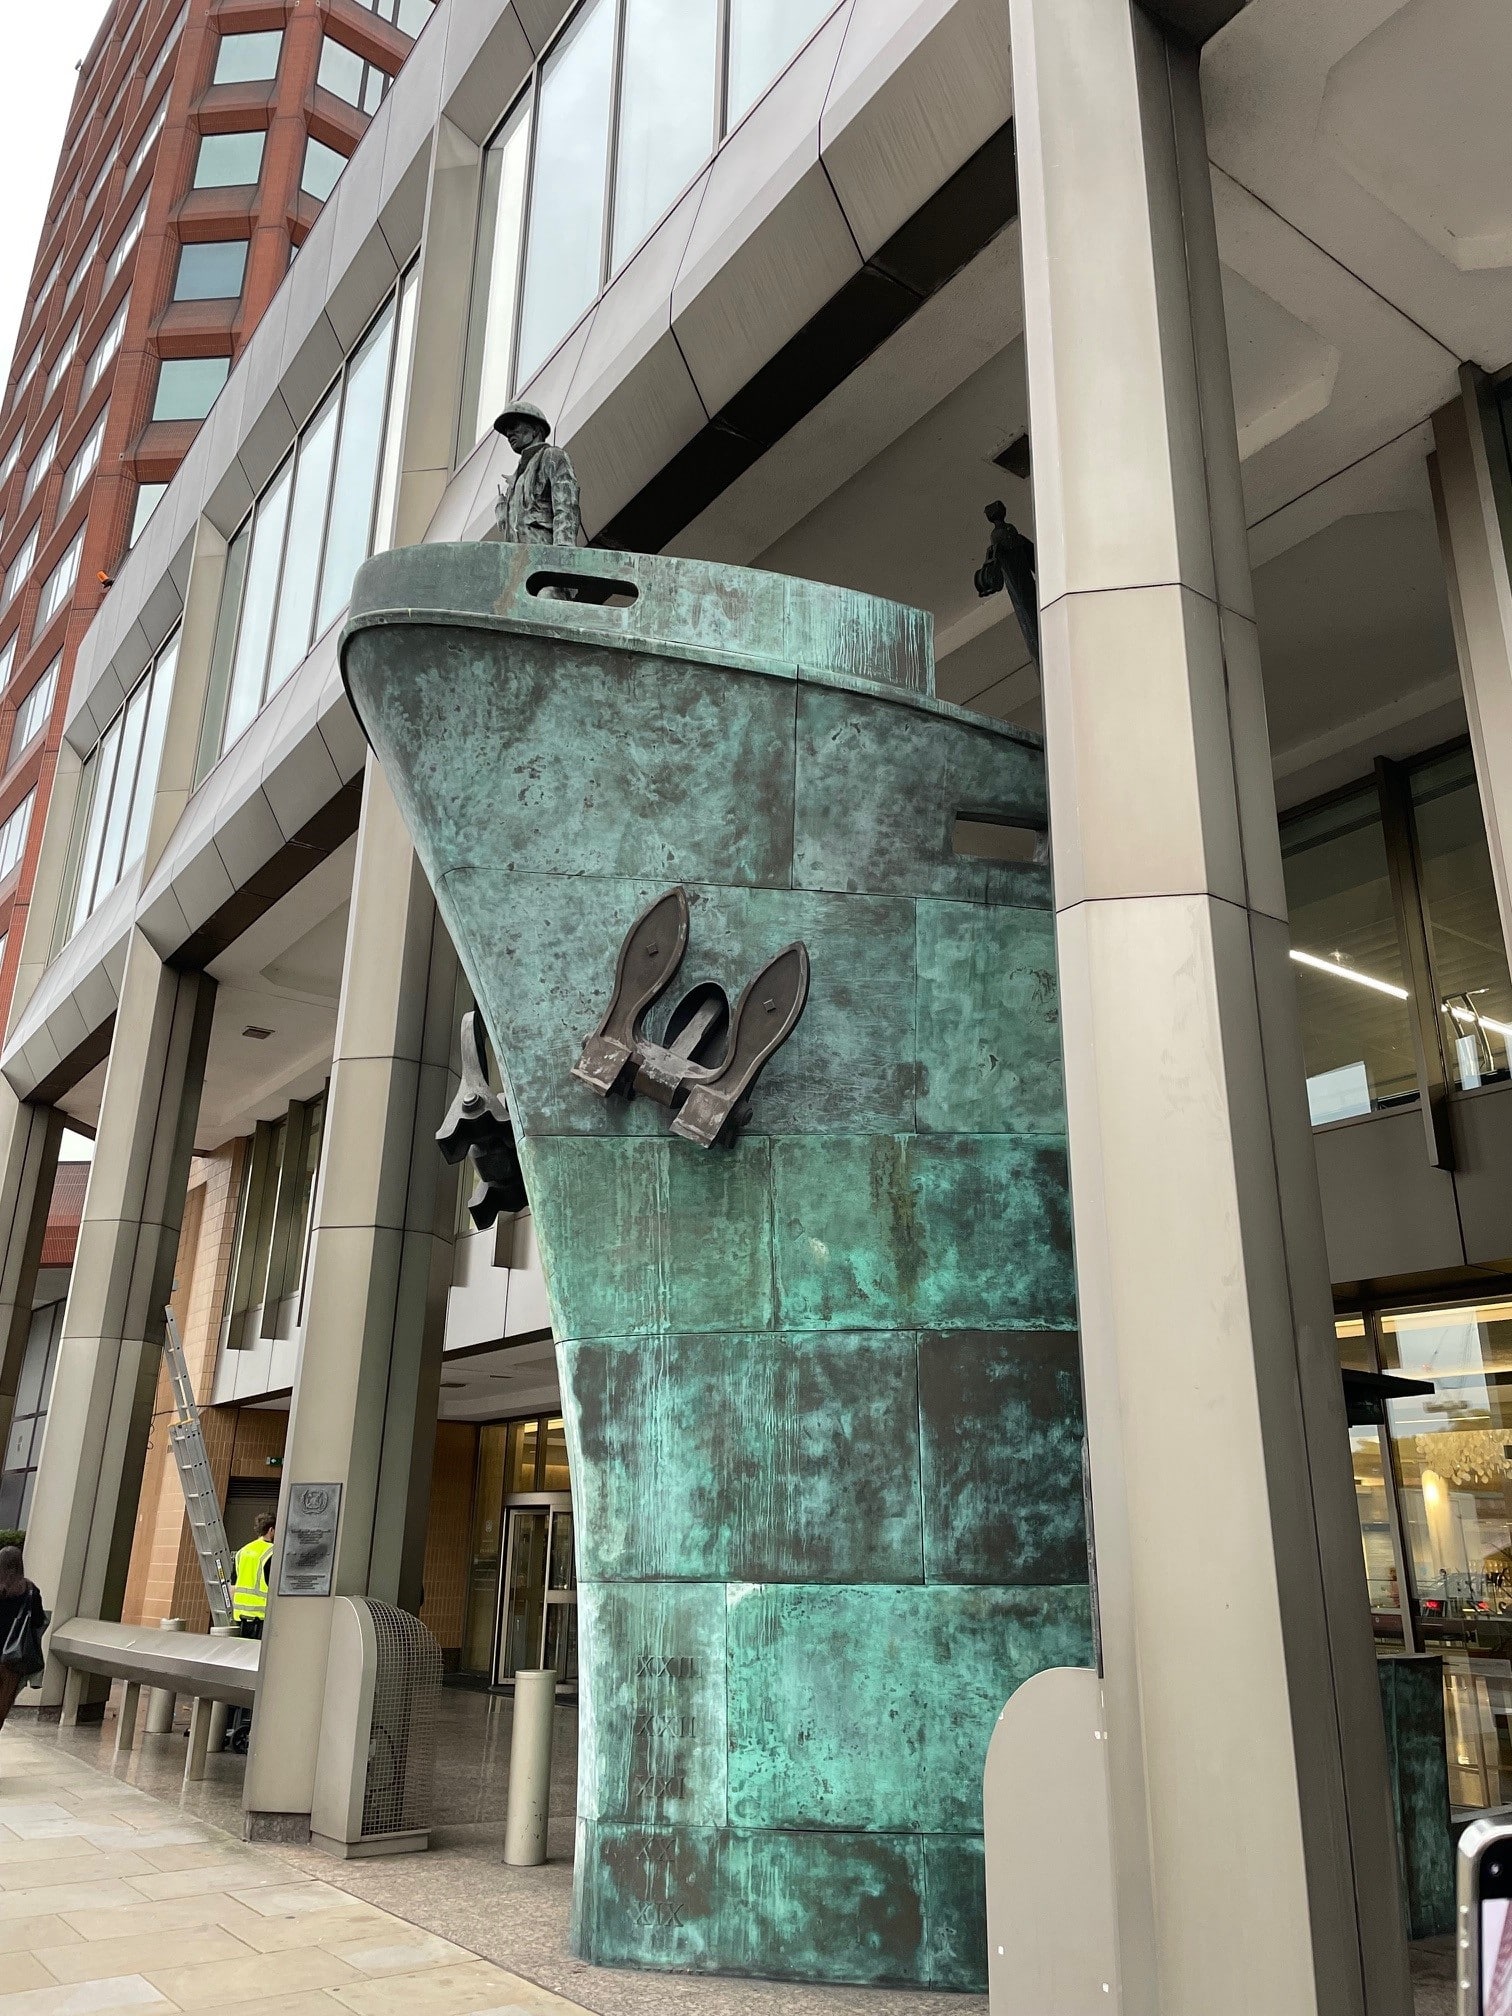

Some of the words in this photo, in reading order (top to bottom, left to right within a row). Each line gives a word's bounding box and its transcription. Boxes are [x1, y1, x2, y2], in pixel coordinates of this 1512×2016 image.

[636, 1655, 703, 1678] XXIII
[636, 1714, 696, 1738] XXII
[635, 1775, 685, 1799] XXI
[636, 1837, 676, 1861] XX
[633, 1901, 684, 1927] XIX
